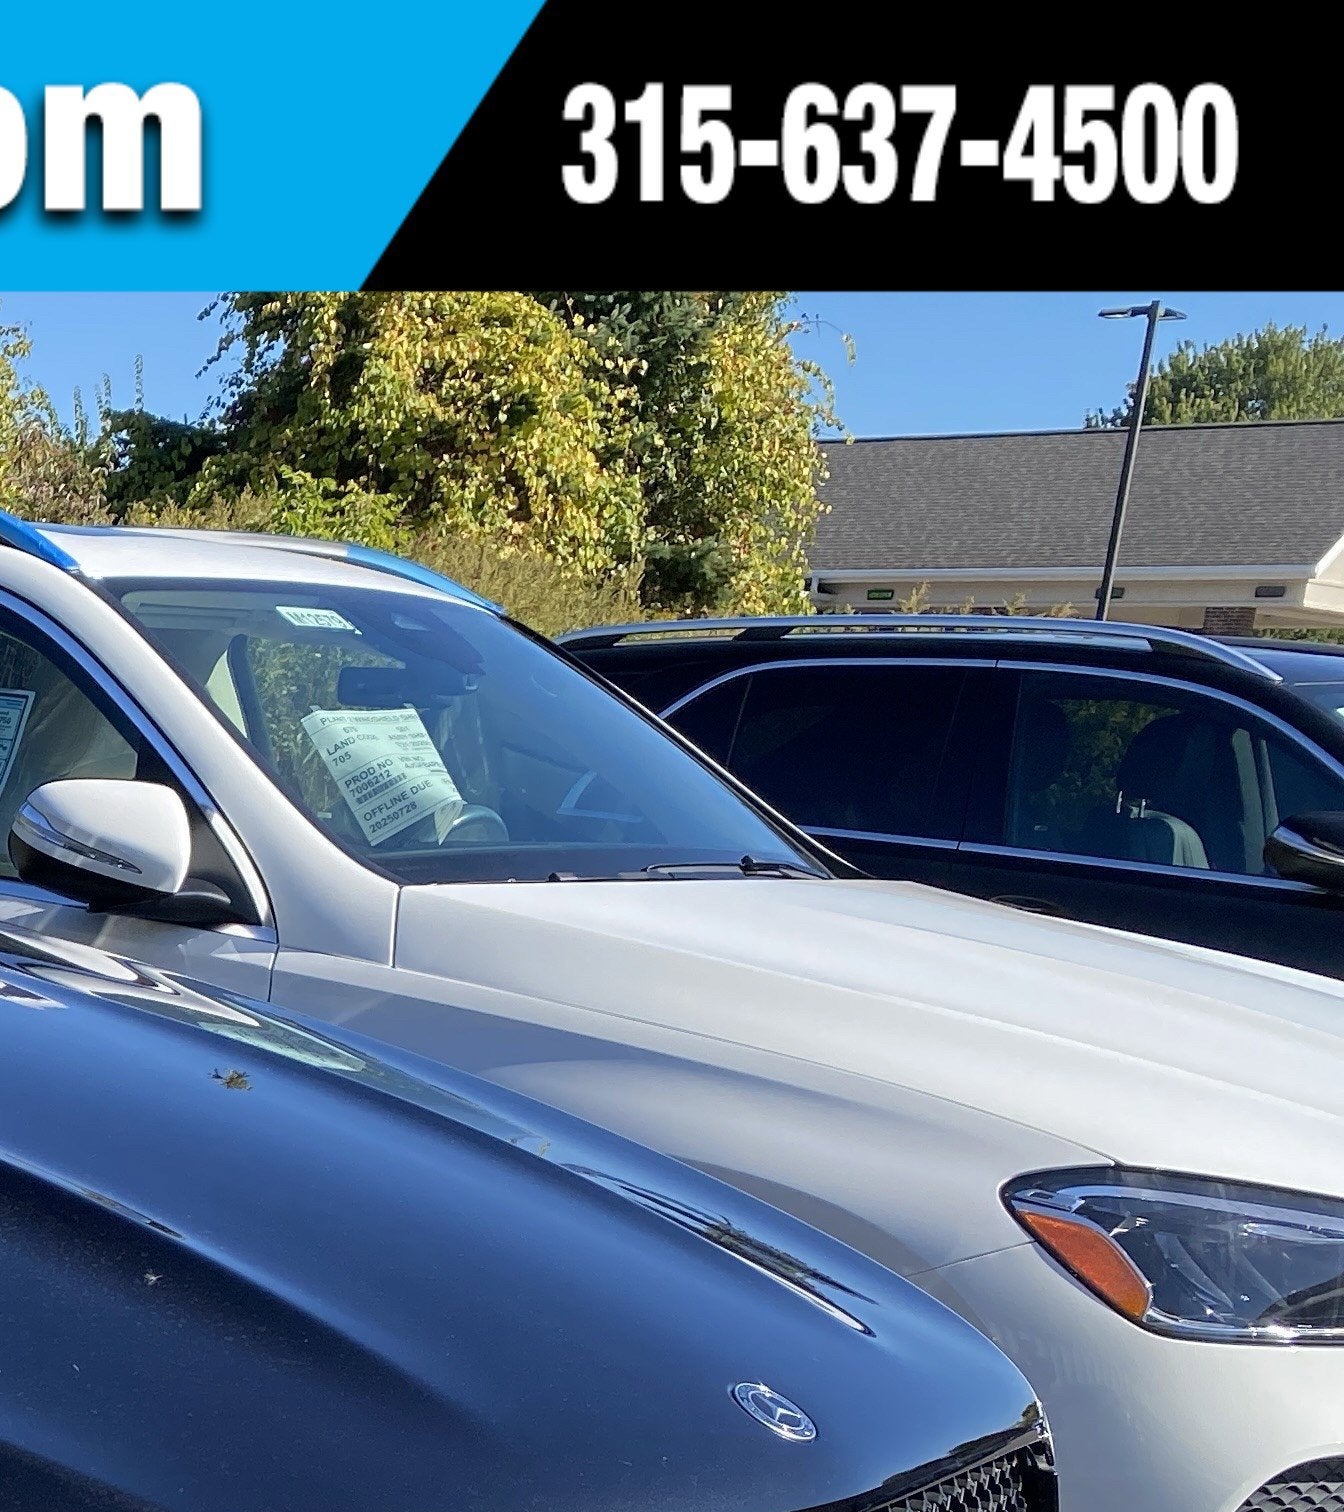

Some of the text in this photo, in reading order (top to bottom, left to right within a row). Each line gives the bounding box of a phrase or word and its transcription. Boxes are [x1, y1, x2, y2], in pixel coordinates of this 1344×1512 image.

[286, 612, 348, 628] M12579
[326, 736, 356, 756] LAND
[332, 751, 352, 766] 705
[345, 766, 376, 788] PROD
[376, 758, 393, 770] NO
[349, 769, 393, 798] 7006212
[363, 790, 410, 821] OFFLINE
[409, 779, 433, 795] DUE
[368, 801, 418, 833] 20250728
